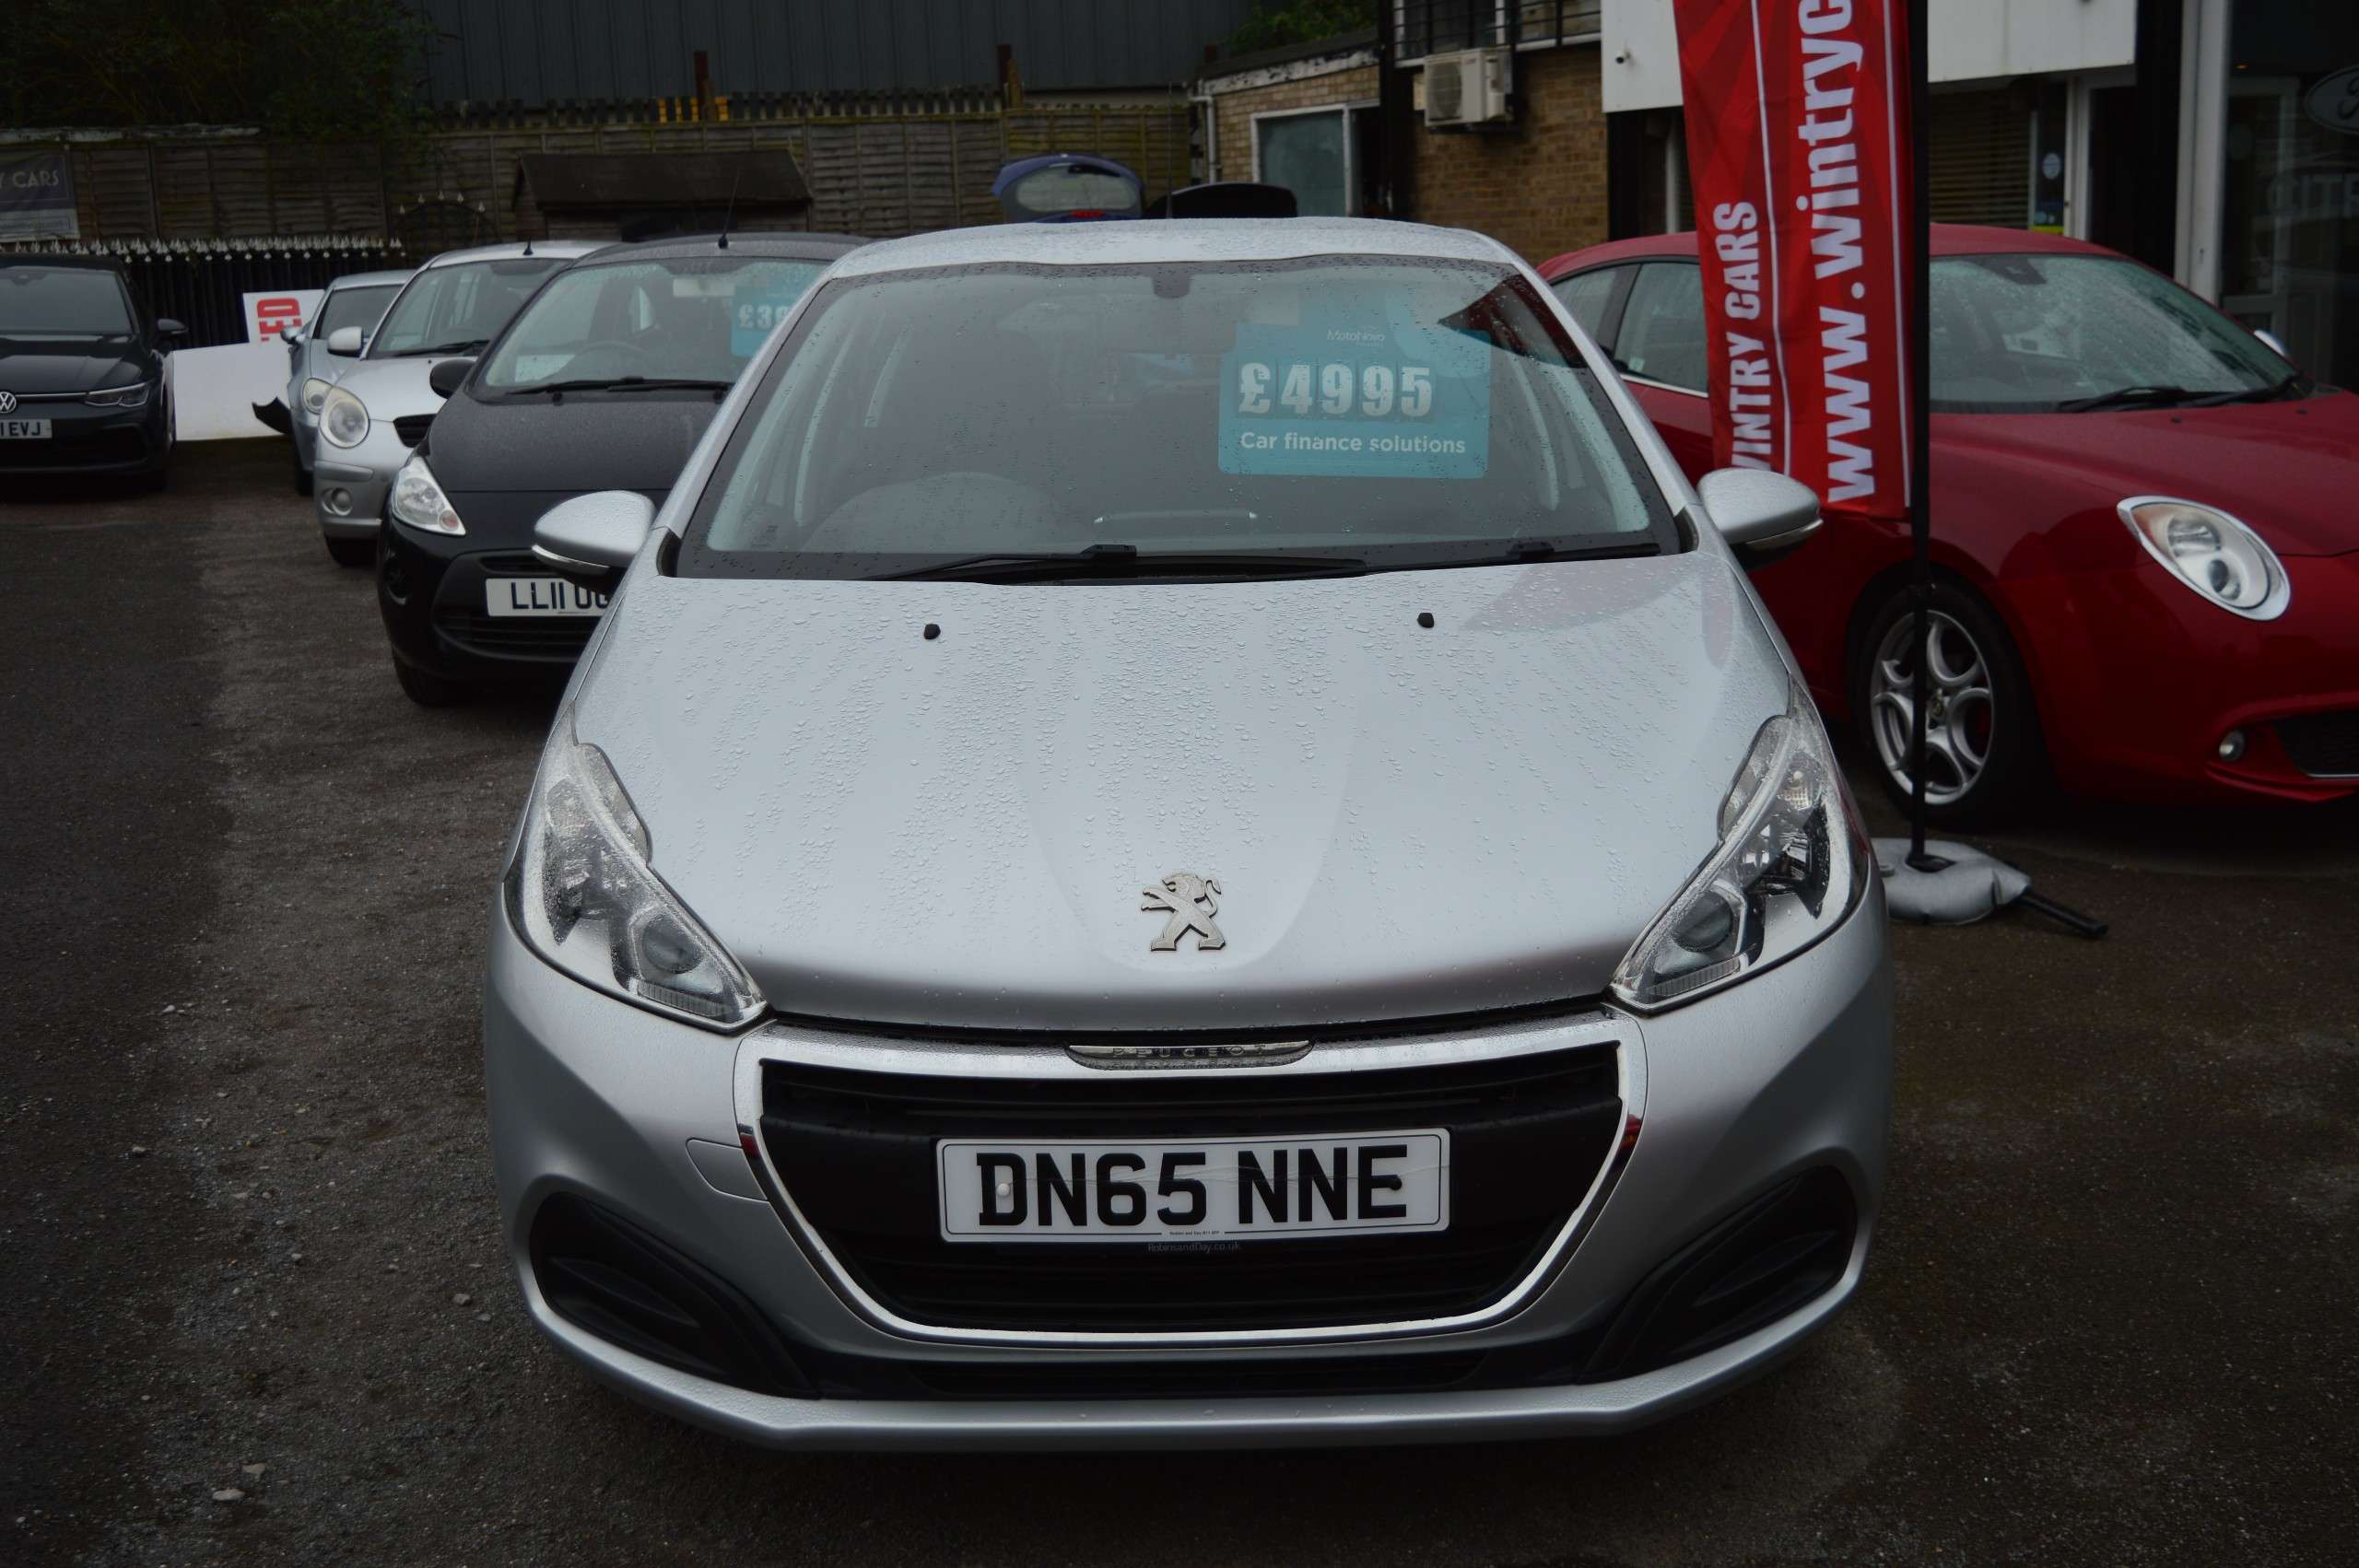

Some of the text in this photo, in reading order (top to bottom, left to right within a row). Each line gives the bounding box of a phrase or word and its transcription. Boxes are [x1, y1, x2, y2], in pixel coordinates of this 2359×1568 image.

[13, 170, 60, 189] CARS
[1712, 202, 1772, 472] INTRY CARS
[1238, 363, 1432, 417] £4995
[9, 422, 41, 436] EVJ
[1239, 431, 1466, 454] Car finance solutions
[511, 582, 565, 609] LL11
[1112, 1044, 1265, 1058] PEUGEOT
[977, 1144, 1408, 1227] DN65 NNE
